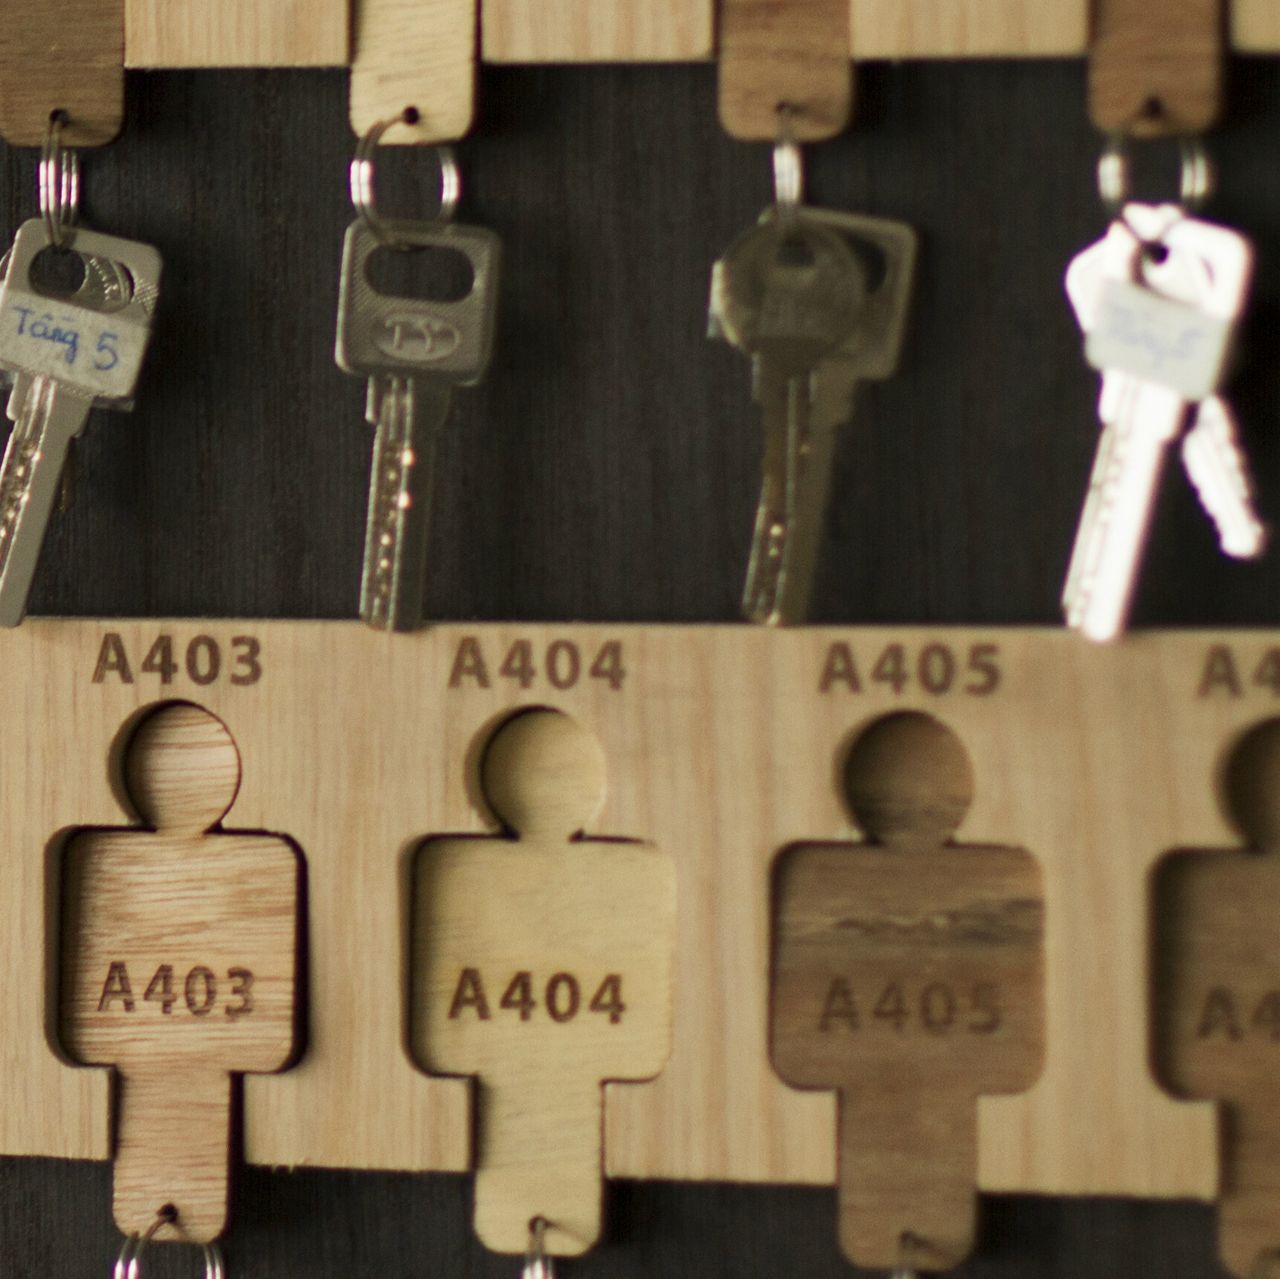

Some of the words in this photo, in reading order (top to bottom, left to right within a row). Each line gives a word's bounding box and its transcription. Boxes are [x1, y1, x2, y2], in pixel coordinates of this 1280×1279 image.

[94, 331, 119, 371] 5
[92, 632, 262, 686] A403
[449, 637, 626, 691] A404
[819, 641, 1001, 696] A405
[97, 961, 255, 1016] A403
[448, 968, 626, 1023] A404
[818, 978, 1003, 1035] A405
